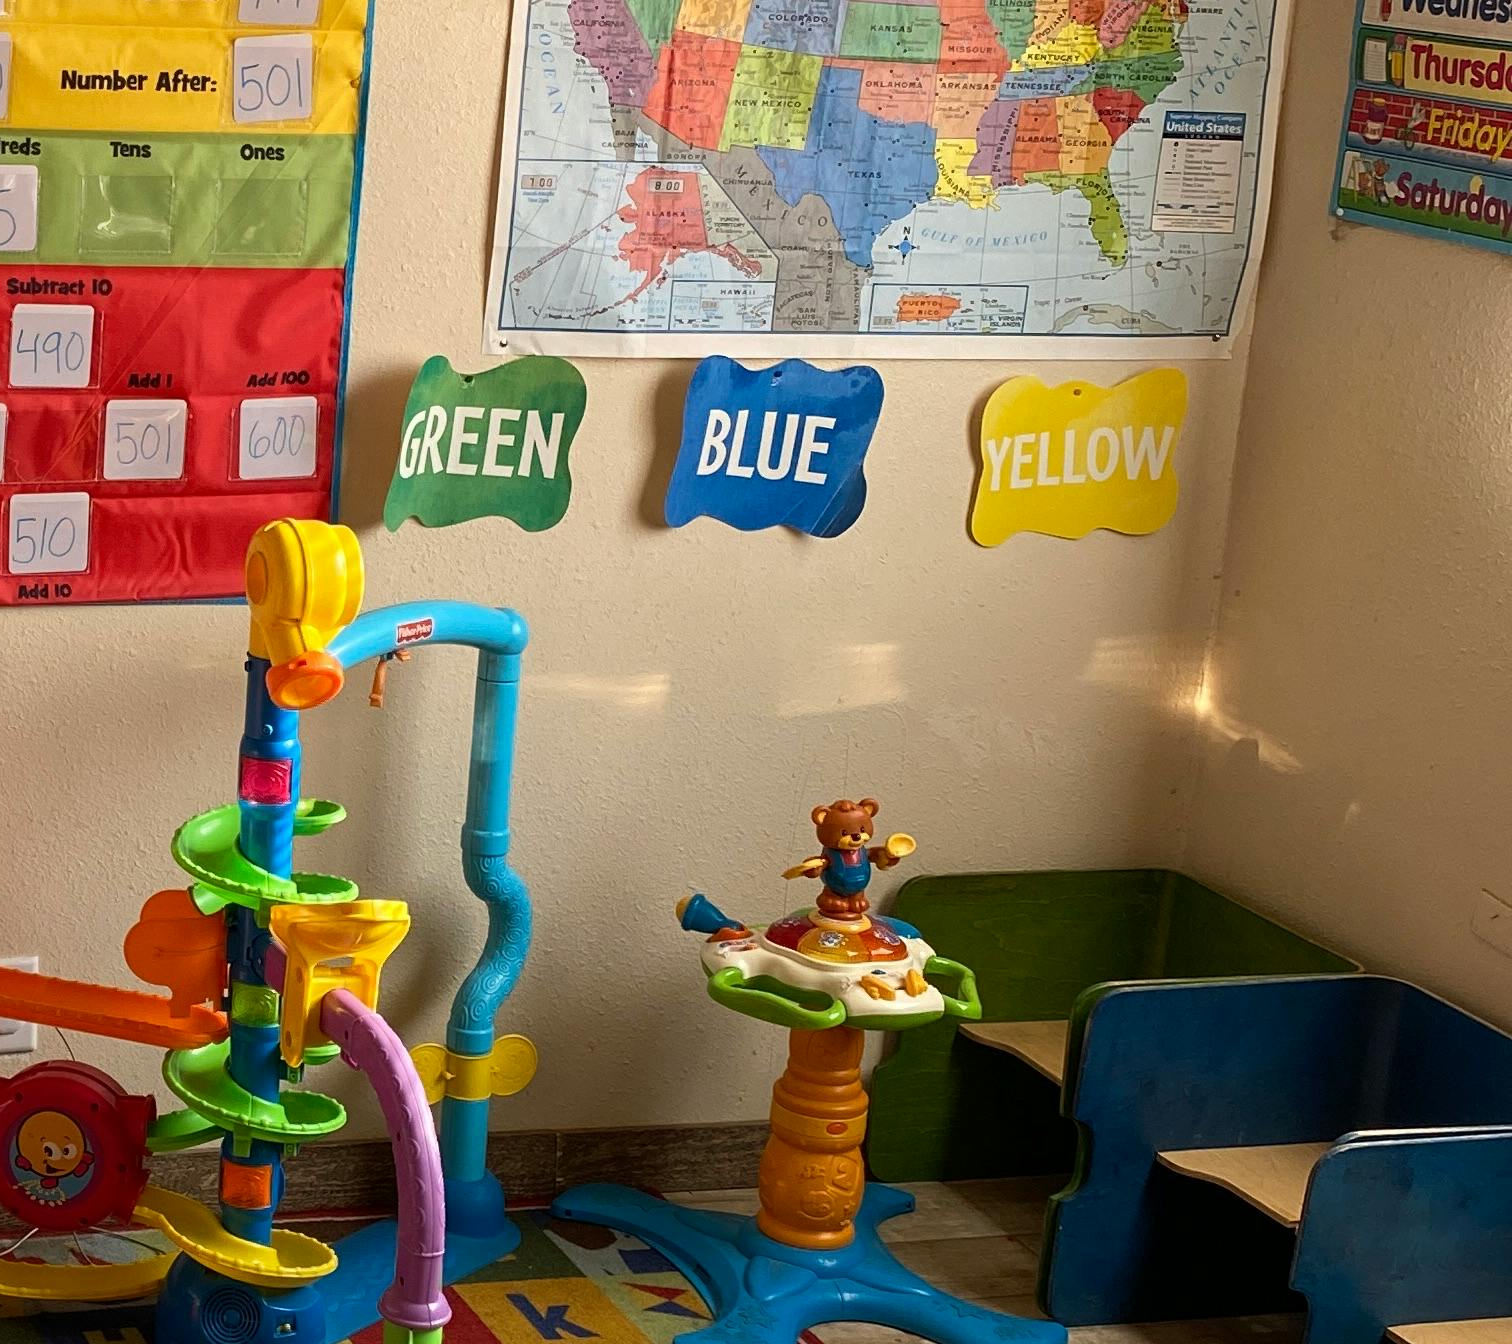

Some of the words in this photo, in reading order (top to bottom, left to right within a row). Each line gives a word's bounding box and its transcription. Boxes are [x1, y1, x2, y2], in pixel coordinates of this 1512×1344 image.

[572, 19, 626, 28] CALIFORNIA
[768, 14, 830, 24] COLORADO
[869, 24, 914, 33] KANSAS
[60, 70, 148, 91] Number
[155, 70, 217, 92] After:
[238, 58, 303, 111] 501
[669, 79, 716, 87] ARIZONA
[864, 80, 924, 90] OKLAHOMA
[940, 82, 997, 91] ARKANSAS
[1005, 82, 1062, 91] TENNESSEE
[1165, 121, 1204, 134] United
[1205, 122, 1243, 134] States
[1426, 108, 1512, 164] Friday
[110, 141, 152, 158] Tens
[240, 144, 285, 161] Ones
[1065, 139, 1108, 148] GEORGIA
[847, 170, 883, 179] TEXAS
[920, 228, 959, 244] GULF
[991, 230, 1049, 247] MEXICO
[6, 277, 85, 296] Subtract
[92, 278, 113, 296] 10
[16, 329, 85, 373] 490
[127, 373, 164, 389] Add
[246, 373, 277, 387] Add
[281, 371, 310, 385] 100
[116, 422, 172, 464] 501
[248, 415, 306, 459] 600
[399, 405, 565, 479] GREEN
[696, 409, 836, 485] BLUE
[985, 426, 1175, 491] YELLOW
[12, 517, 76, 564] 510
[18, 584, 49, 598] Add
[54, 584, 72, 597] 10
